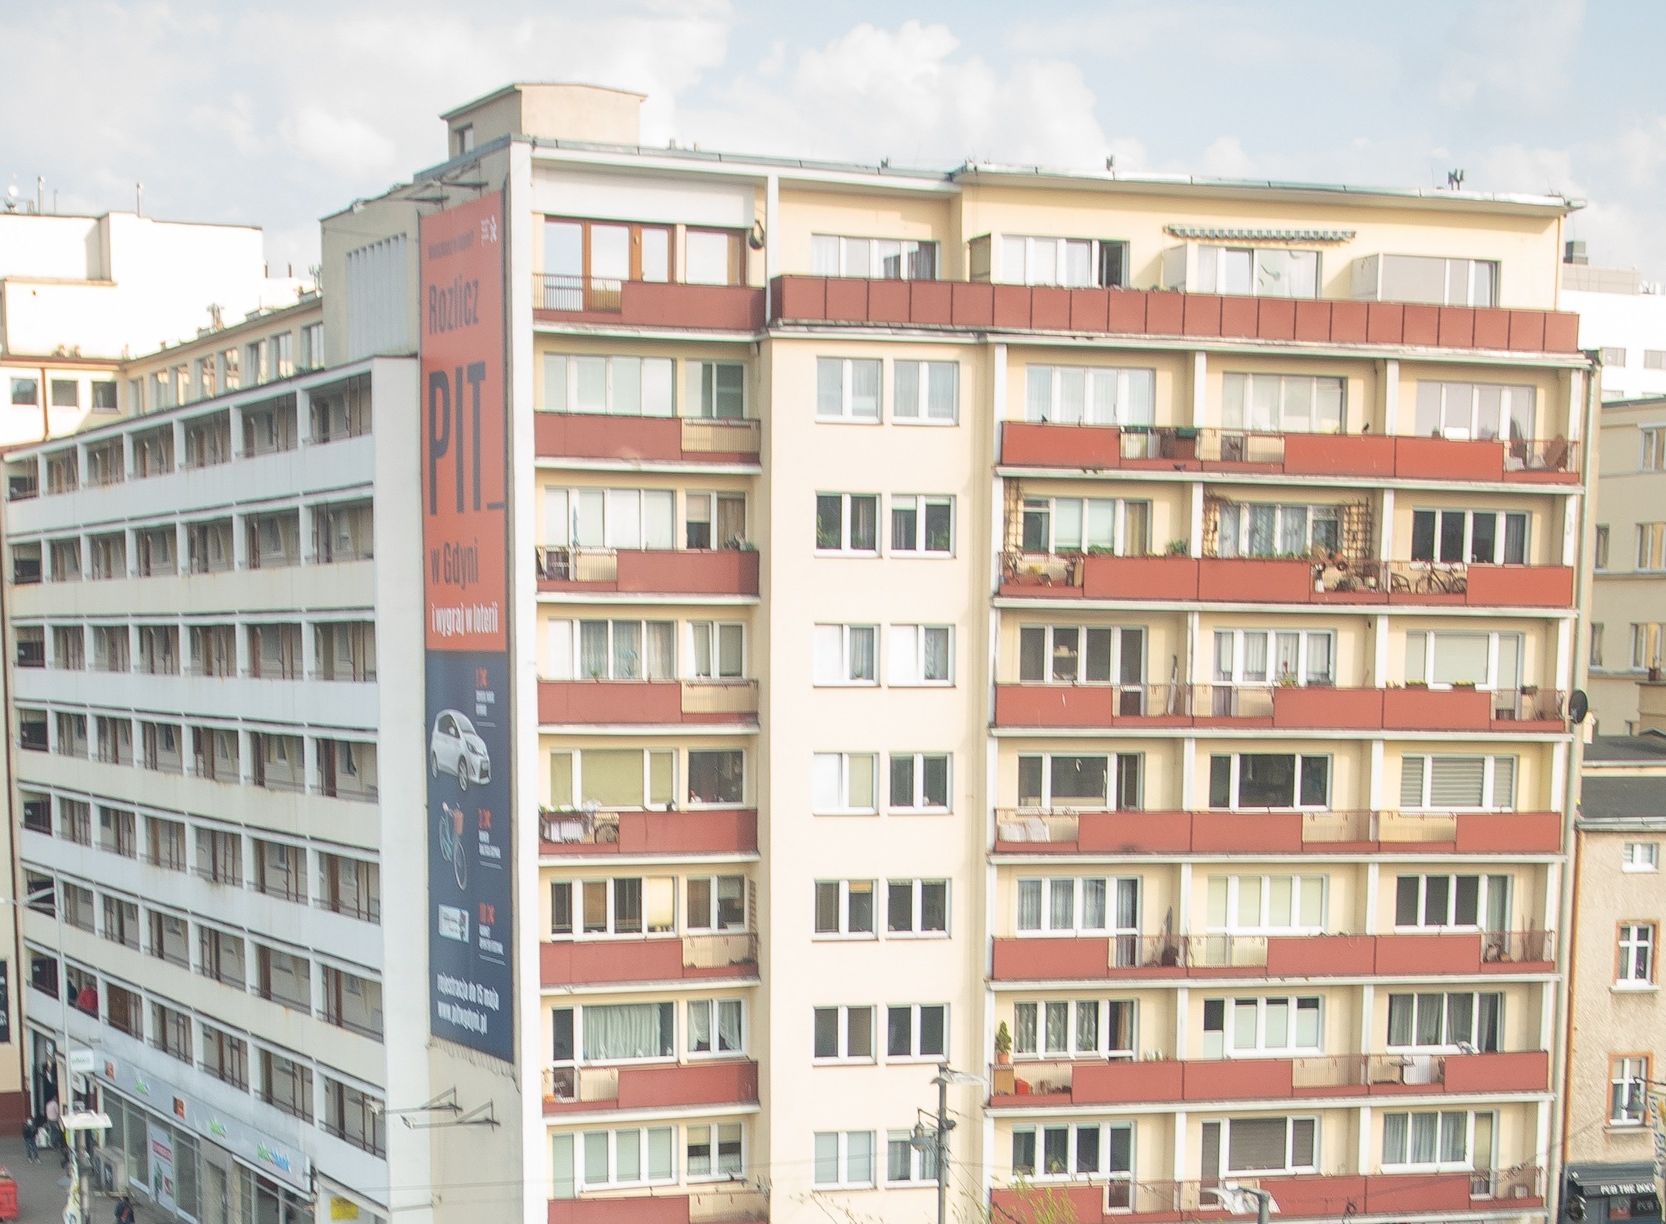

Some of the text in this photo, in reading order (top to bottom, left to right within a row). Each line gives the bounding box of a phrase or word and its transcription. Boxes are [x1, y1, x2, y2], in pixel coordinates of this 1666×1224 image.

[428, 274, 479, 335] Rozlicz
[430, 537, 478, 590] w Gdyni
[436, 602, 464, 637] wygraj
[473, 601, 498, 633] loterii
[1600, 1184, 1618, 1195] PUB
[1618, 1183, 1636, 1194] THE
